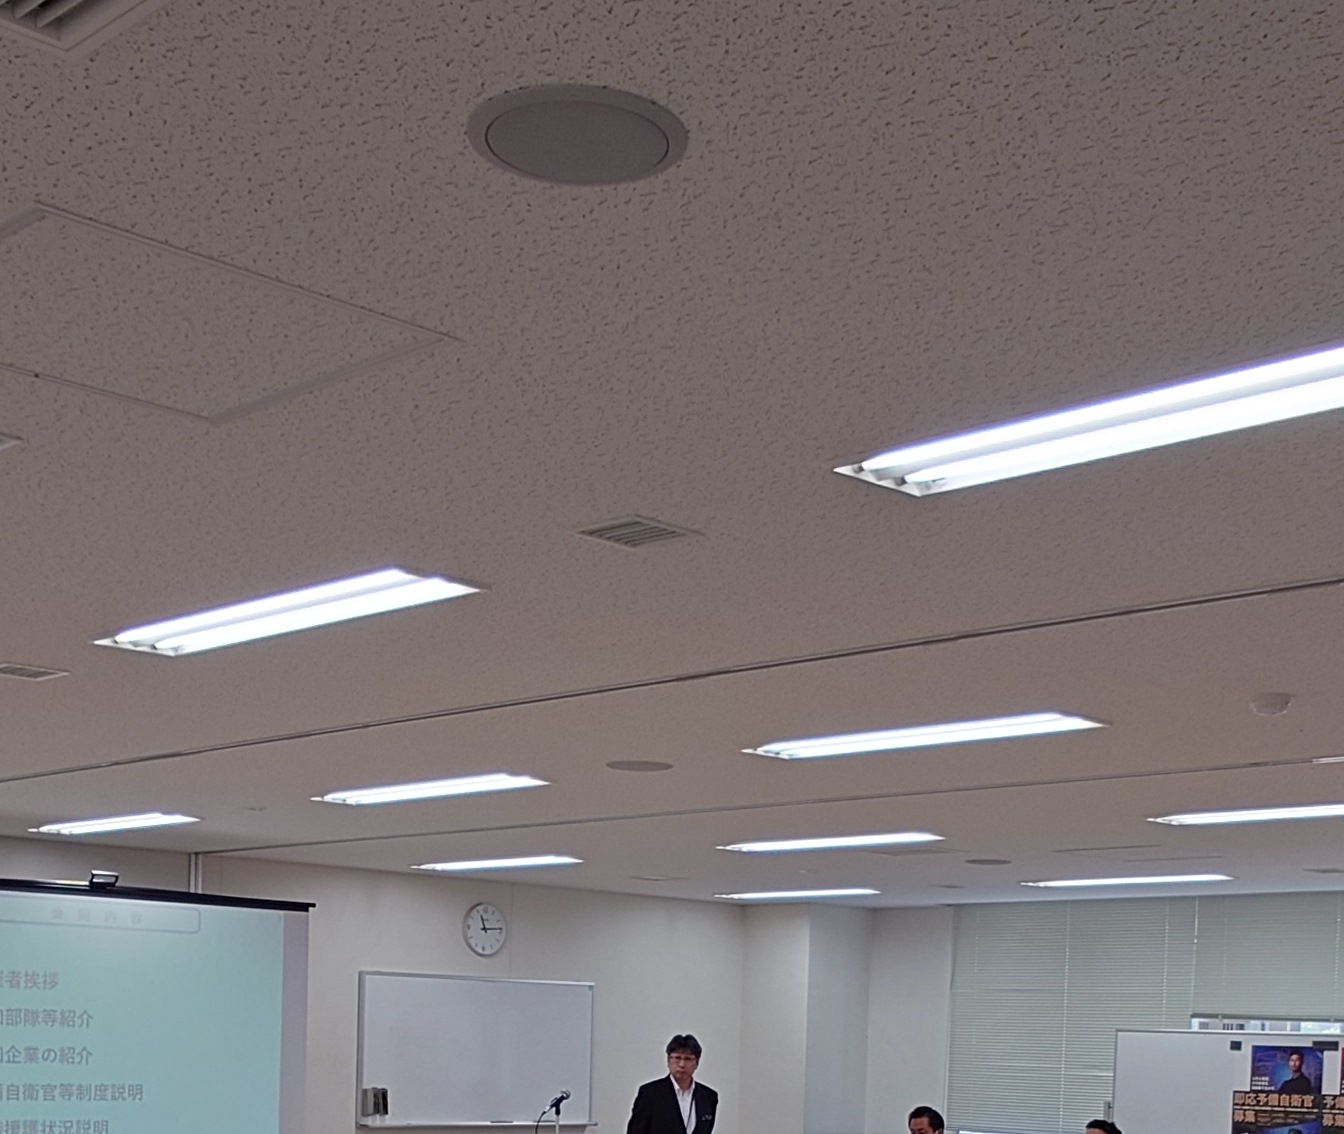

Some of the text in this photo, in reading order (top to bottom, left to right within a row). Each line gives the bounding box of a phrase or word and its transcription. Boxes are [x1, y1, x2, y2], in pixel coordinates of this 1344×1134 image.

[1233, 1092, 1314, 1108] 即応予備自衛官
